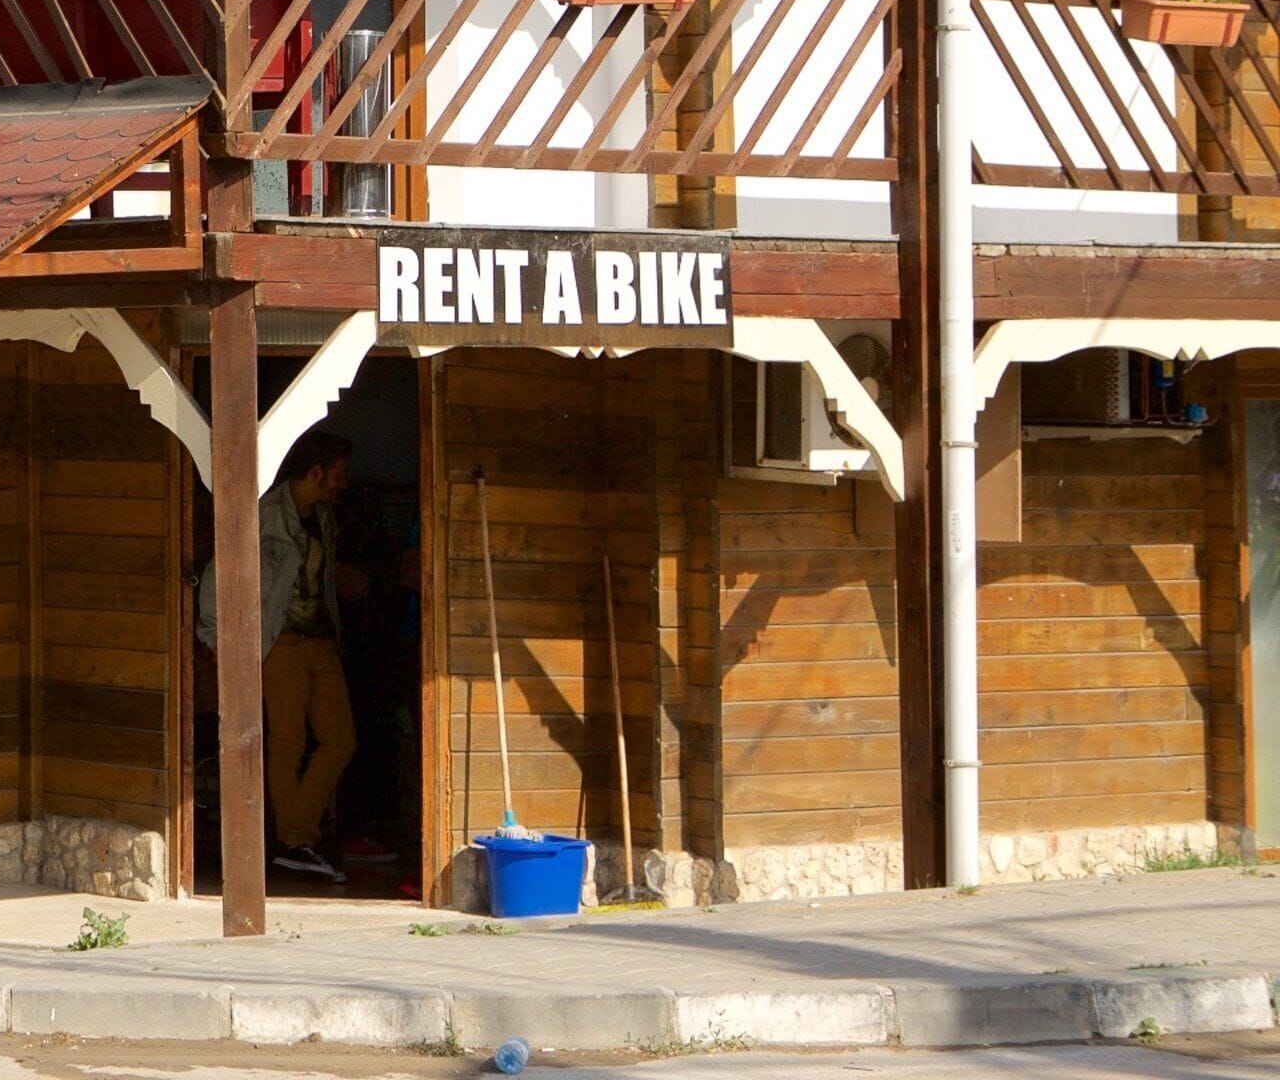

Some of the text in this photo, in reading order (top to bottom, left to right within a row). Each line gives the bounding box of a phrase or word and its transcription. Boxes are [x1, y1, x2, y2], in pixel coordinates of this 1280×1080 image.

[378, 246, 727, 326] RENT A BIKE
